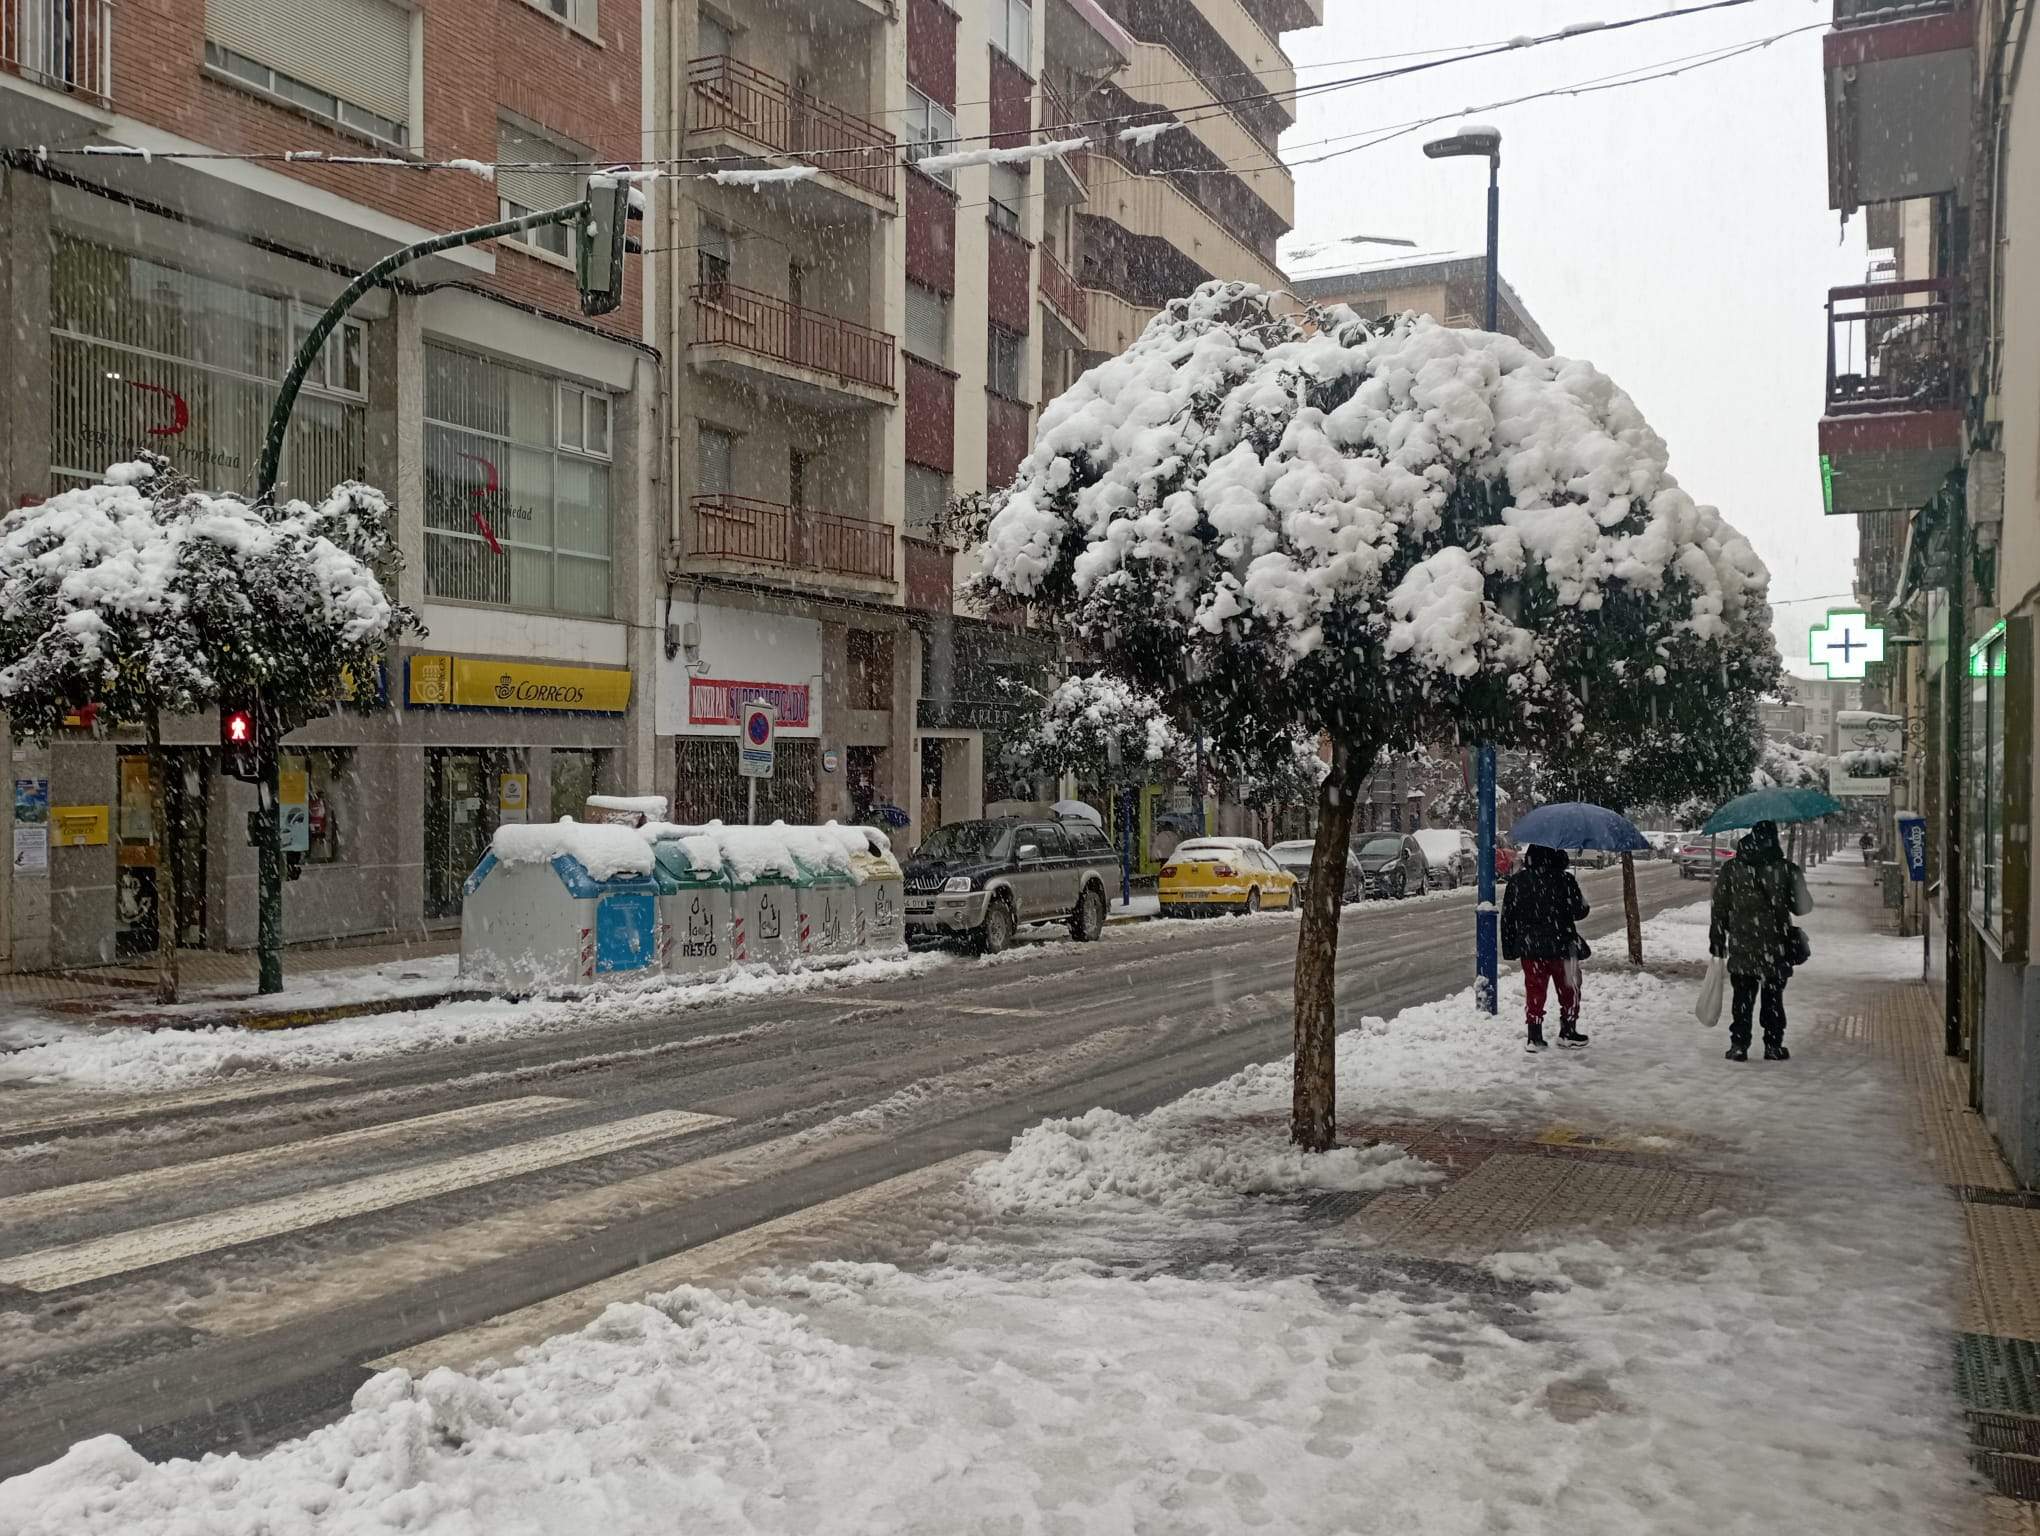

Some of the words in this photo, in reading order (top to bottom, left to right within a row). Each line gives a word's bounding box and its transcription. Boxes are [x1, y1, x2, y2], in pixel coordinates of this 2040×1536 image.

[176, 441, 241, 470] Propiedad
[516, 680, 584, 703] CORREOS
[729, 687, 806, 722] SUERCADO
[1910, 825, 1925, 870] CONTROL
[683, 944, 717, 957] RESTO
